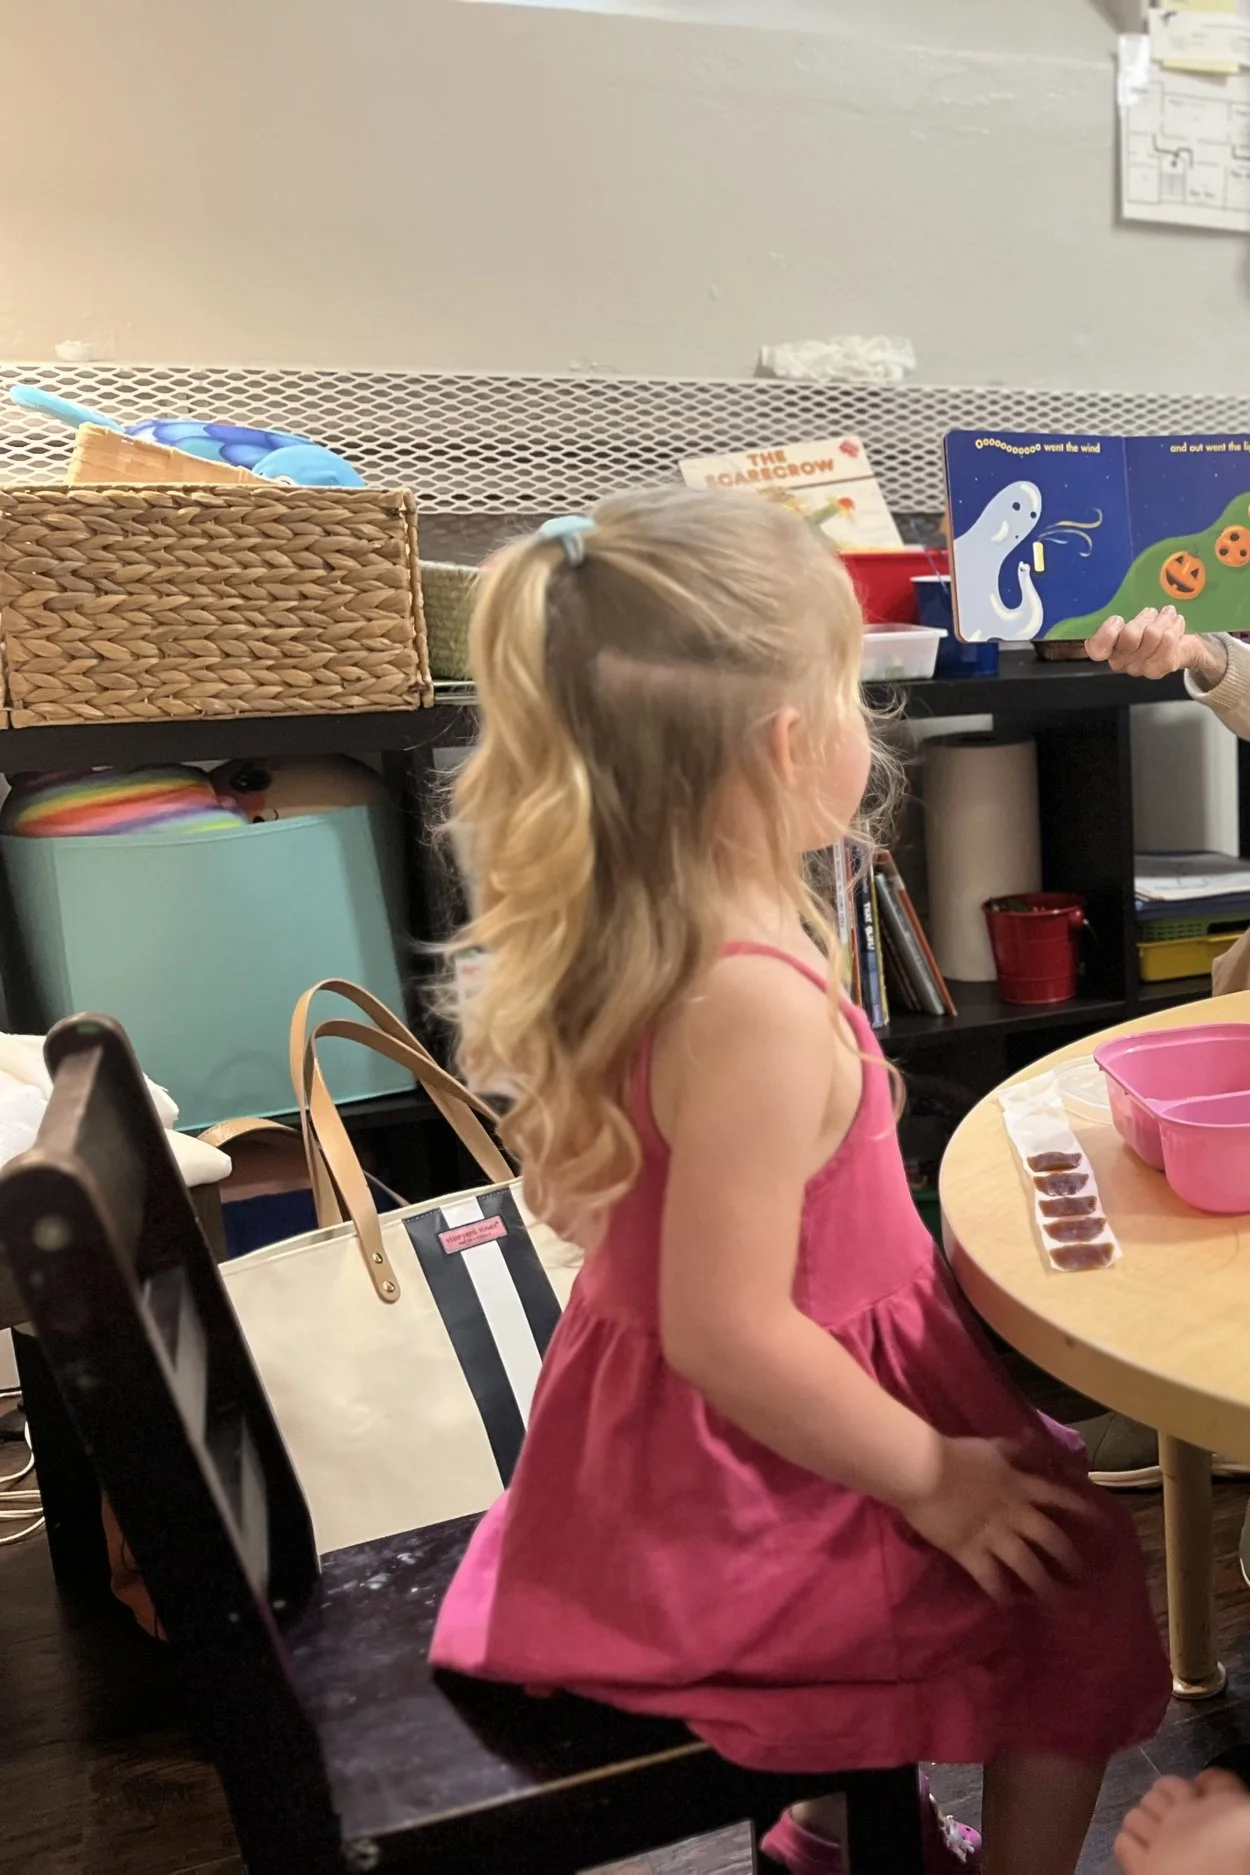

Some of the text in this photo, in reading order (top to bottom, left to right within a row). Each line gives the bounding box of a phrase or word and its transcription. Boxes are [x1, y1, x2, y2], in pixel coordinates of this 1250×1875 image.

[1043, 443, 1064, 452] went
[1066, 441, 1078, 452] the
[1081, 443, 1100, 453] wind
[1170, 442, 1187, 452] and
[1189, 443, 1203, 452] out
[1205, 442, 1226, 452] went
[1228, 440, 1241, 451] the
[746, 450, 787, 466] THE
[705, 459, 833, 488] SCARECROW
